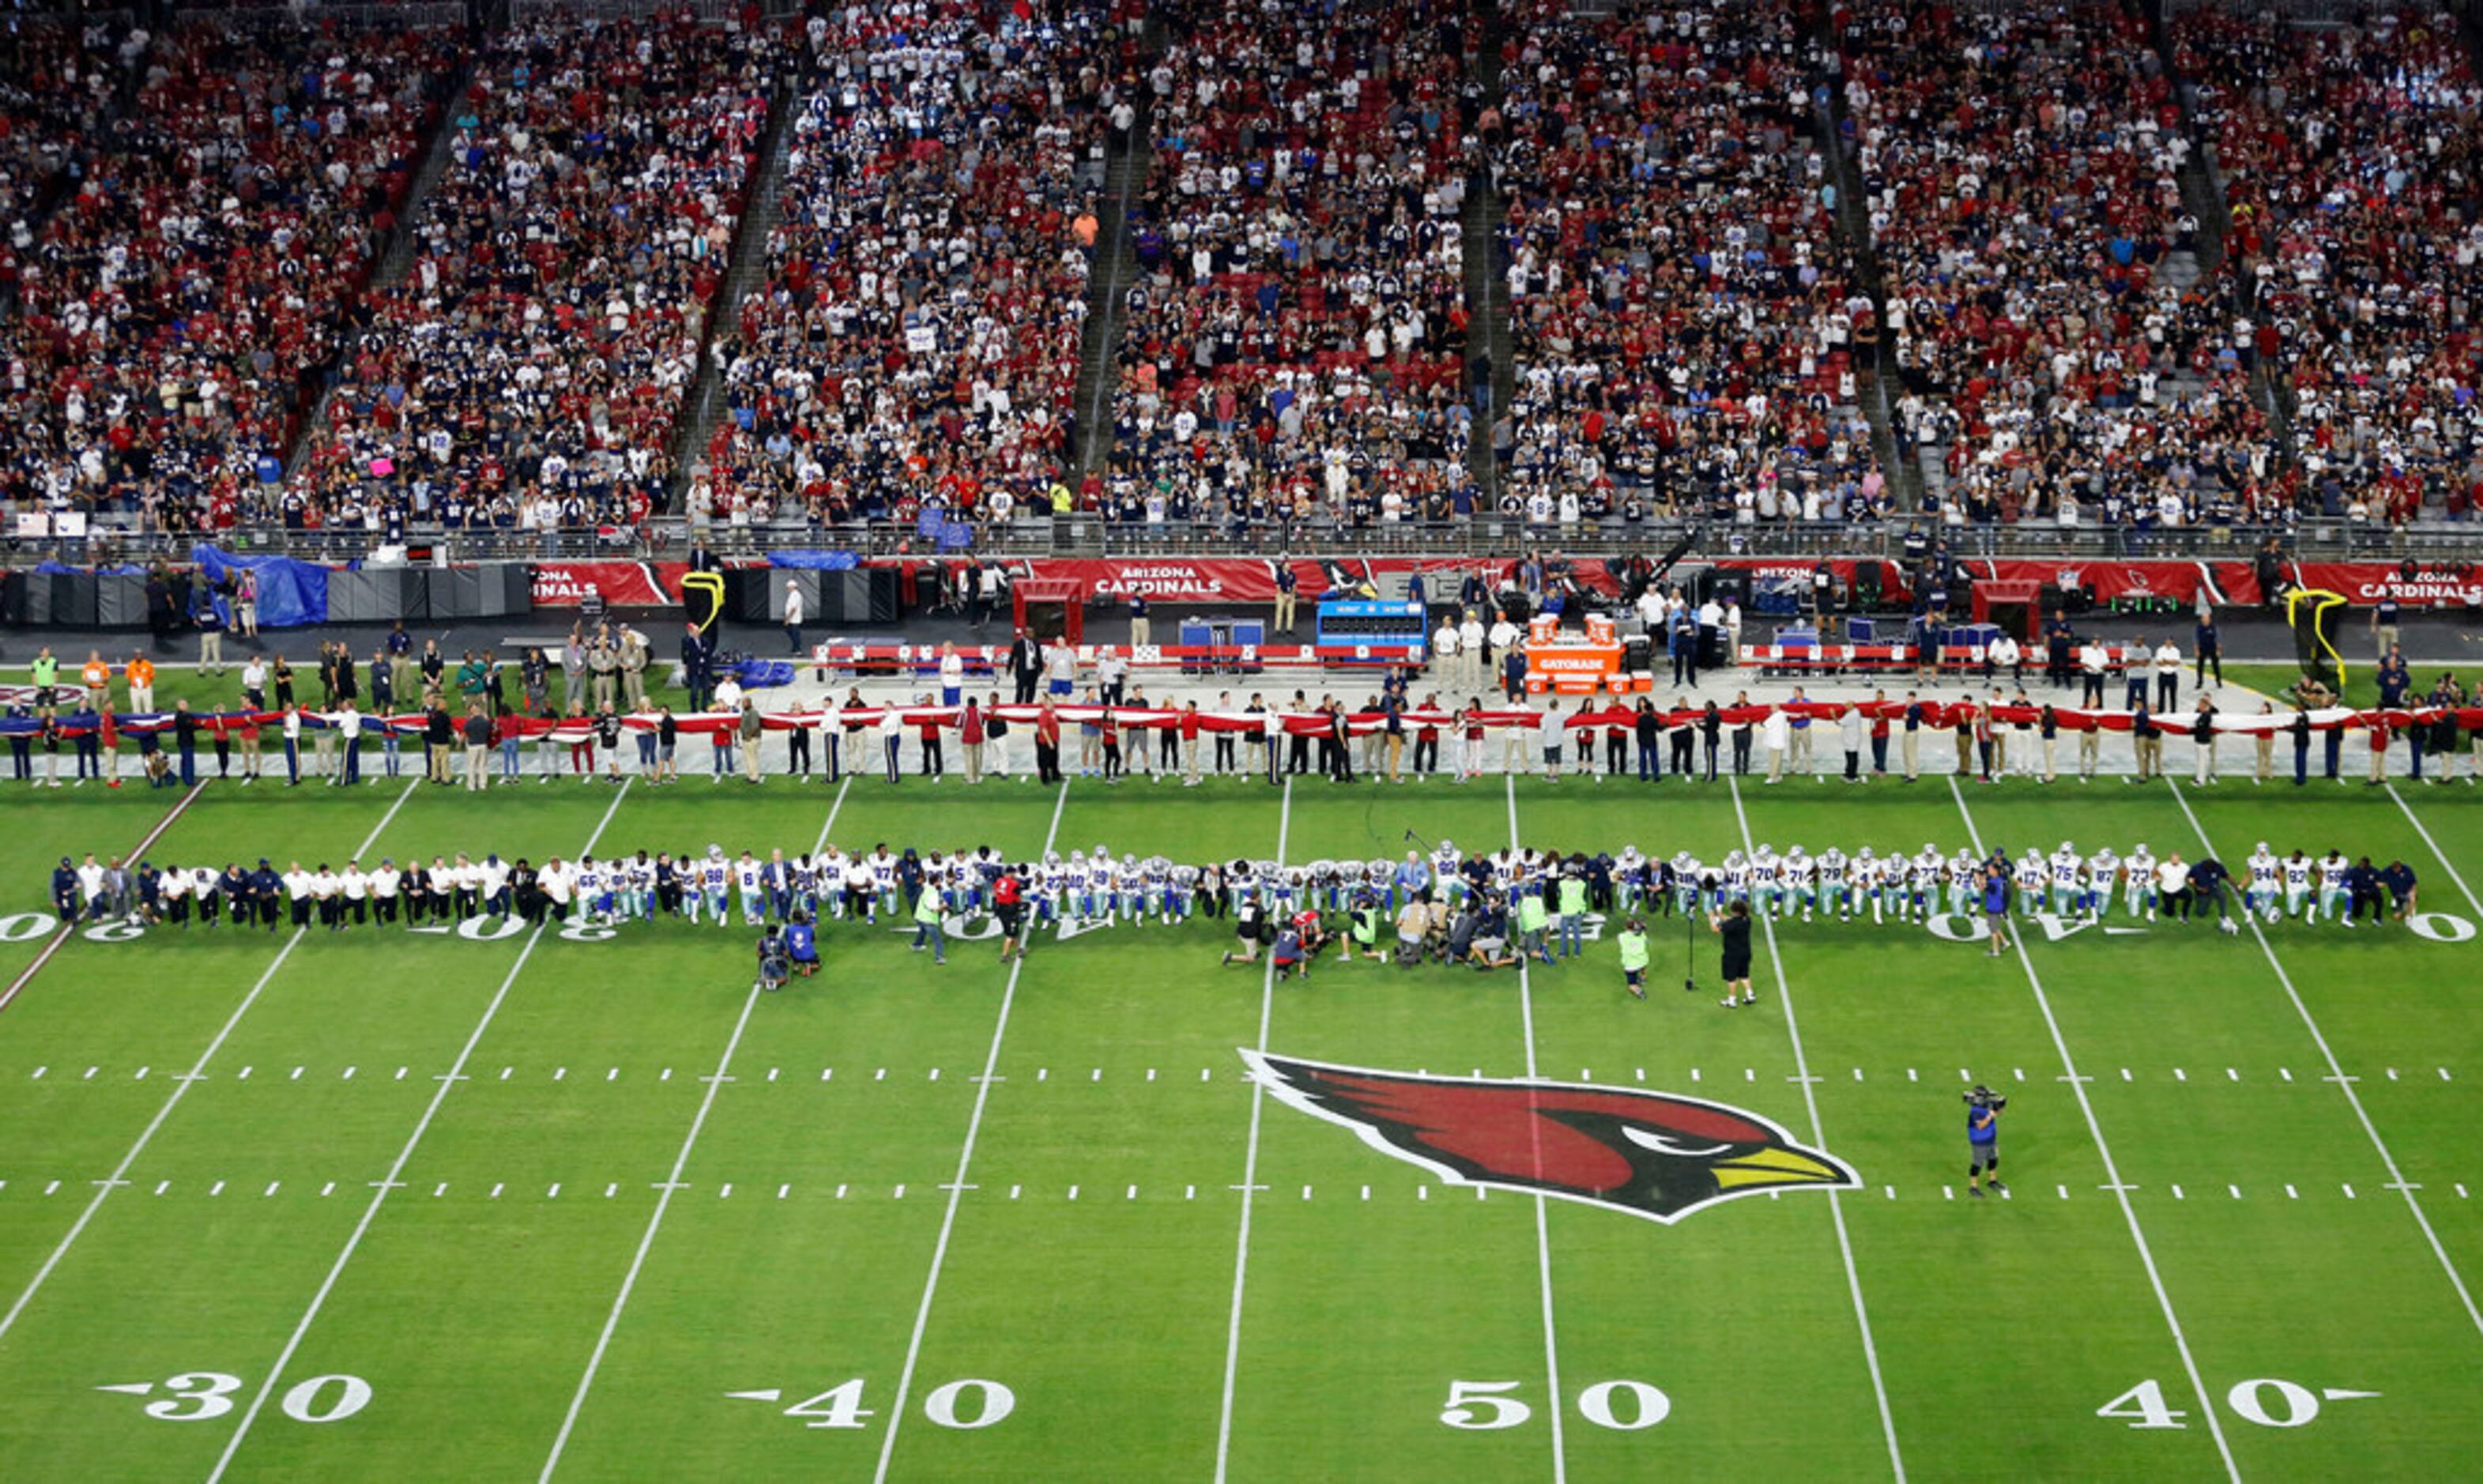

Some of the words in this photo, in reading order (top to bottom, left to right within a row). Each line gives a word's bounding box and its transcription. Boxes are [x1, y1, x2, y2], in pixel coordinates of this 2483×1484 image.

[1121, 567, 1196, 578] ARIZONA
[530, 583, 597, 597] INALS
[1095, 579, 1223, 593] CARDINALS
[1539, 659, 1605, 670] GATORADE
